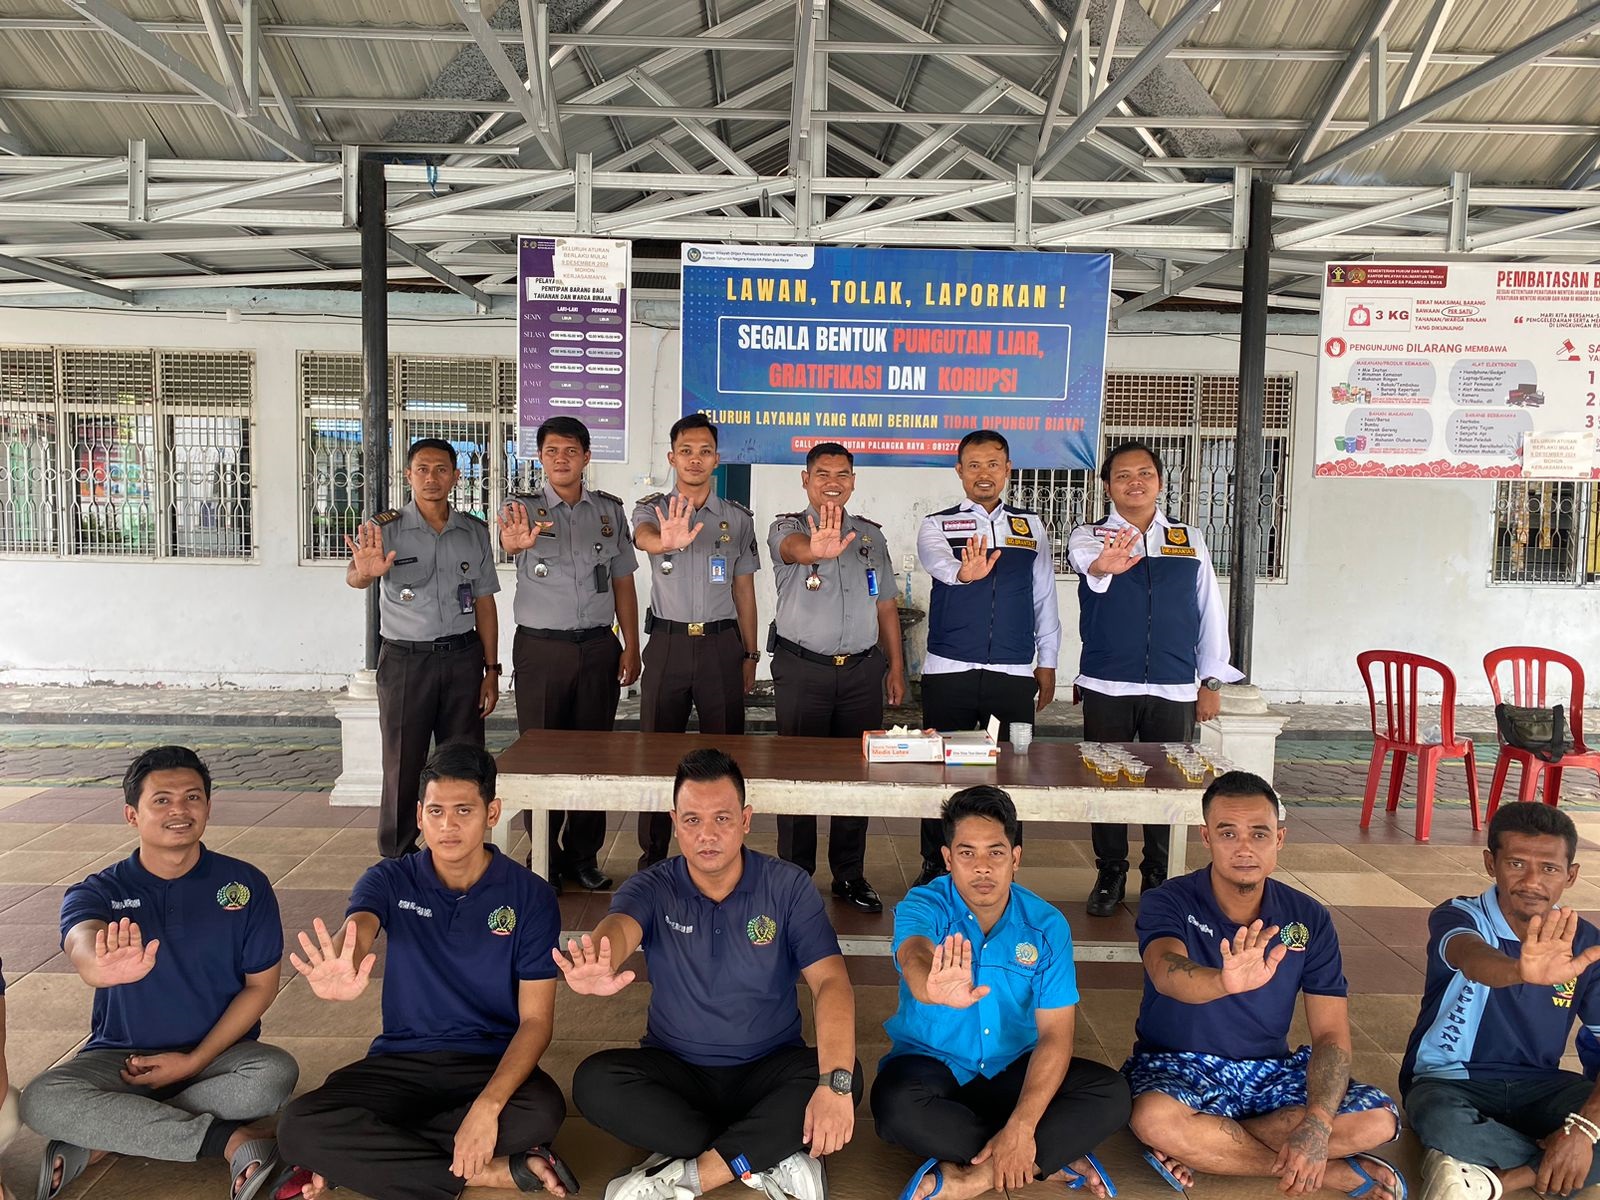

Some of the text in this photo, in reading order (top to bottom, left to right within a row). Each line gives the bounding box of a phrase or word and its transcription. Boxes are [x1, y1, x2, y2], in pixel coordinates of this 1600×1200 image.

[1496, 270, 1590, 288] PEMBATASAN
[726, 277, 1066, 308] LAWAN, TOLAK, LAPORKAN !
[1375, 310, 1409, 320] 3 KG
[738, 324, 1044, 359] SEGALA BENTUK PUNGUTAN LIAR,
[1350, 344, 1404, 352] PENGUNJUNG
[1406, 344, 1462, 354] DILARANG
[769, 363, 1018, 393] GRATIFIKASI DAN KORUPSI
[1588, 370, 1595, 384] 1
[1586, 392, 1596, 406] 2
[756, 411, 810, 426] LAYANAN
[816, 412, 847, 427] YANG
[852, 413, 882, 428] KAMI
[888, 414, 938, 428] BERIKAN
[943, 415, 977, 430] TIDAK
[982, 416, 1040, 430] DIPUNGUT
[1044, 417, 1085, 432] BIAYA!
[1585, 414, 1594, 428] 3
[795, 440, 810, 448] CALL
[843, 441, 865, 450] RUTAN
[868, 441, 904, 450] PALANGKA
[907, 442, 924, 450] RAYA
